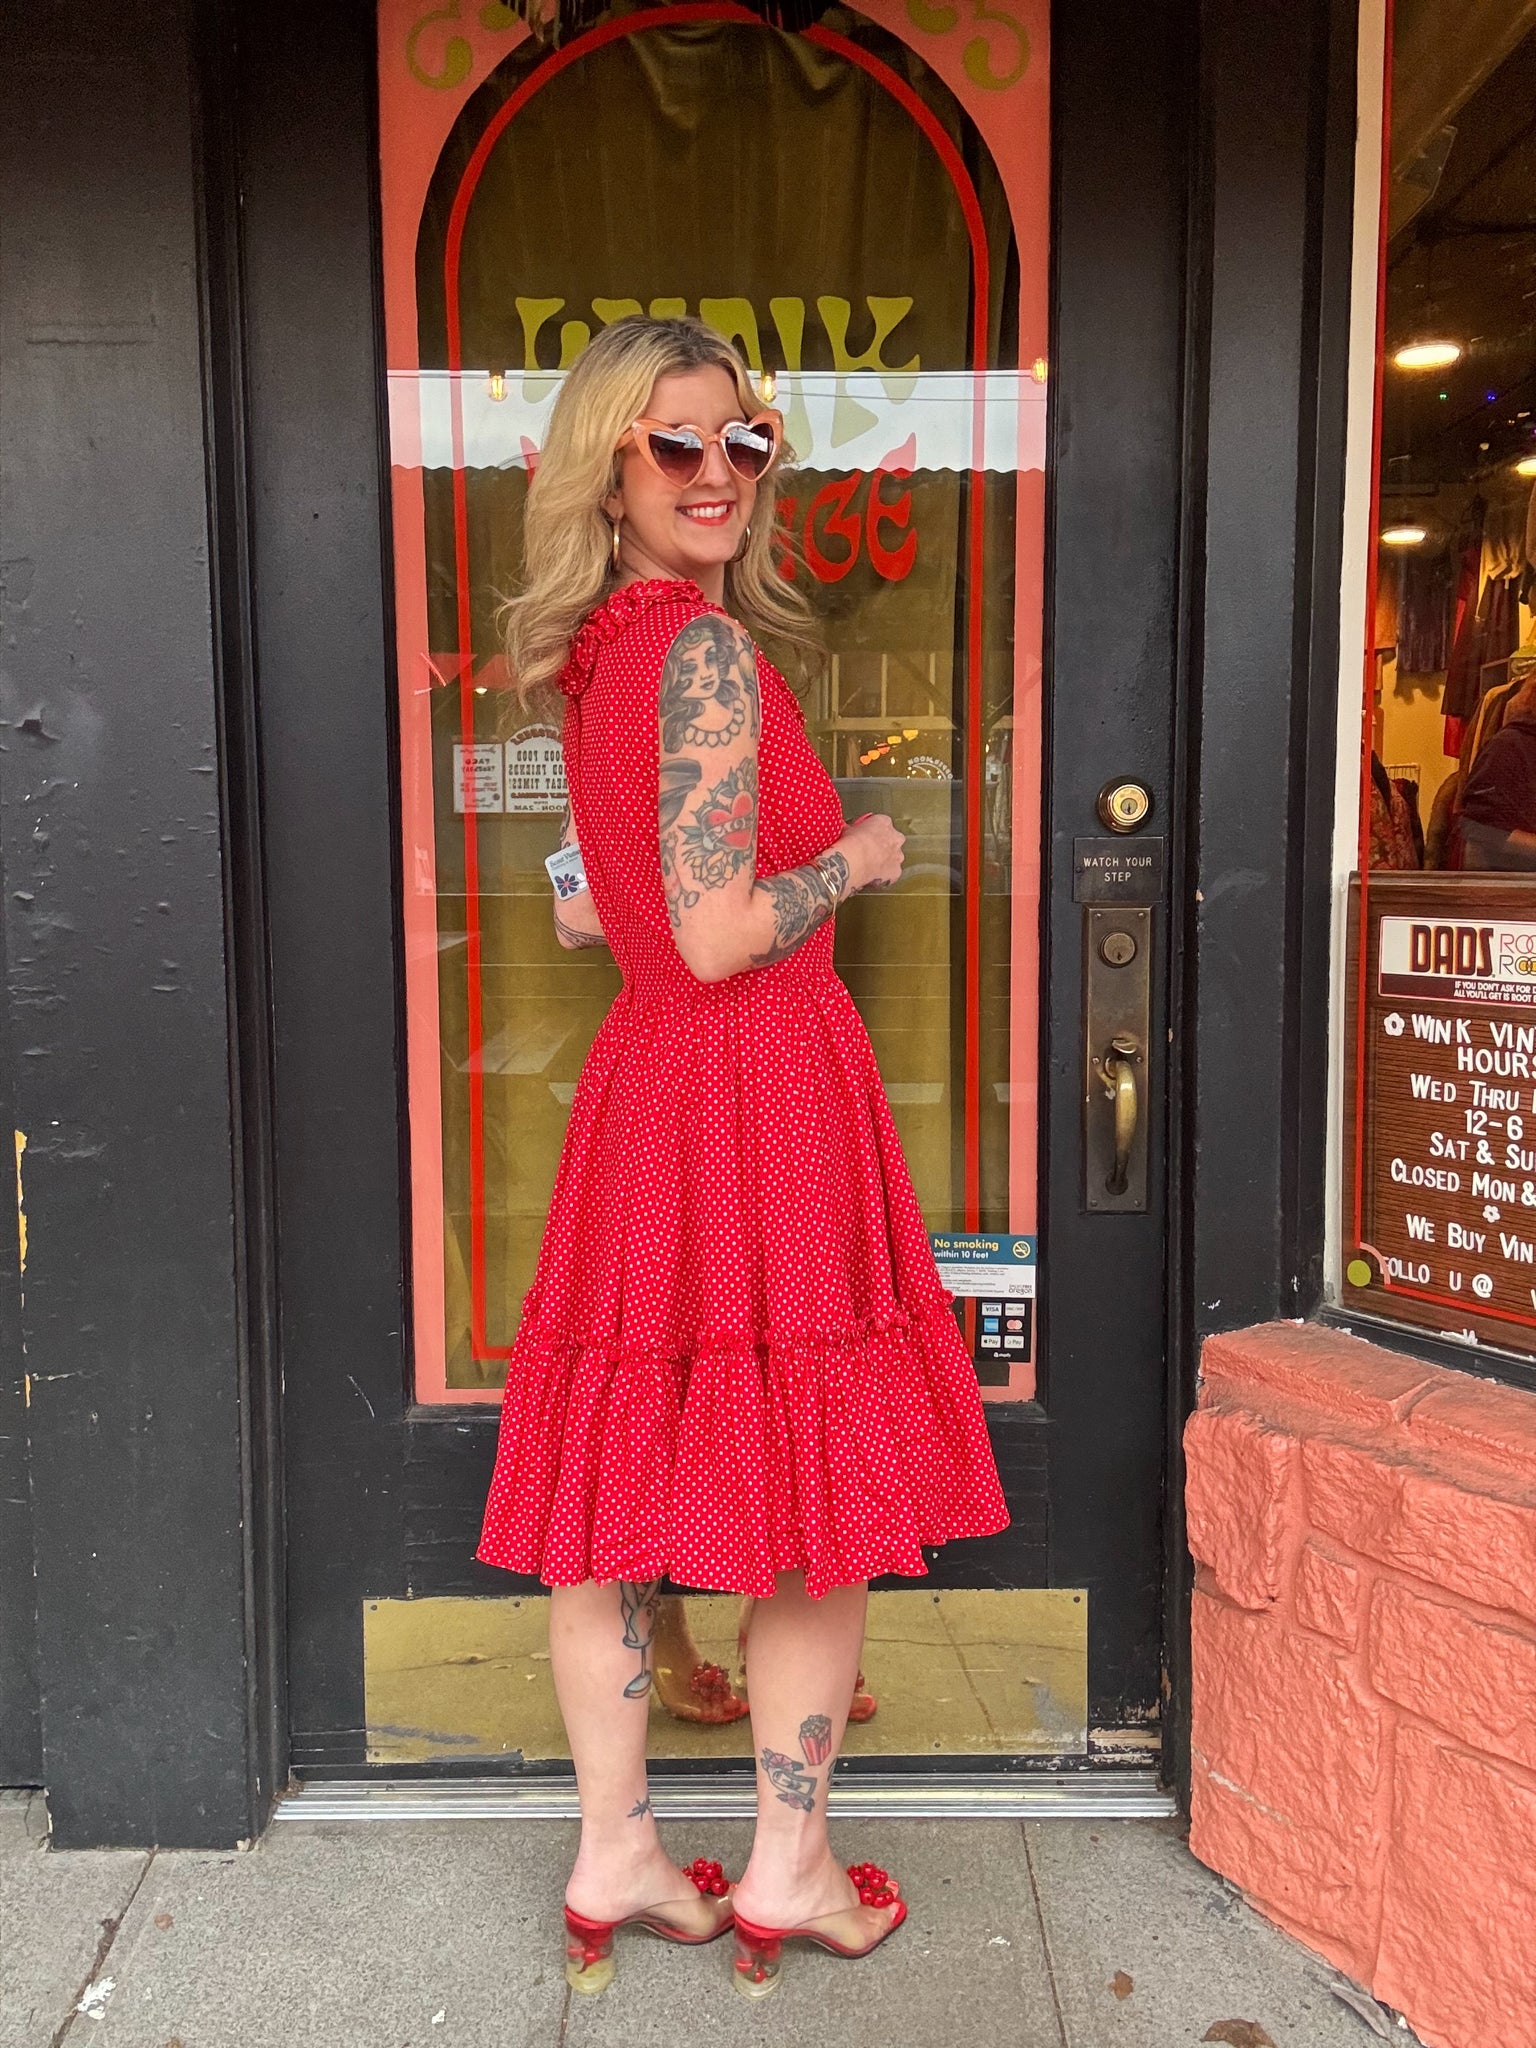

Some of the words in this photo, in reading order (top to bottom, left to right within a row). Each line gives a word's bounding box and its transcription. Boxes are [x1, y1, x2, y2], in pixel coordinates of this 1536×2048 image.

[1083, 857, 1119, 868] WATCH
[1125, 856, 1152, 867] YOUR
[1104, 872, 1132, 882] STEP
[1454, 980, 1461, 989] IF
[1462, 981, 1476, 990] YOU
[1477, 982, 1499, 991] DON'T
[1500, 984, 1515, 993] ASK
[1516, 985, 1531, 994] FOR
[1453, 989, 1465, 997] ALL
[1465, 990, 1488, 999] YOU'LL
[1488, 992, 1502, 1000] GET
[1503, 993, 1510, 1001] IS
[1510, 993, 1532, 1002] ROOT
[1489, 1021, 1536, 1054] VIN
[1475, 1139, 1496, 1166] &
[1504, 1143, 1536, 1172] SU
[934, 1238, 950, 1248] No
[953, 1238, 999, 1251] smoking
[933, 1249, 959, 1258] within
[961, 1250, 970, 1258] 10
[972, 1250, 989, 1259] feet
[1449, 1270, 1462, 1291] U
[1472, 1273, 1493, 1299] @
